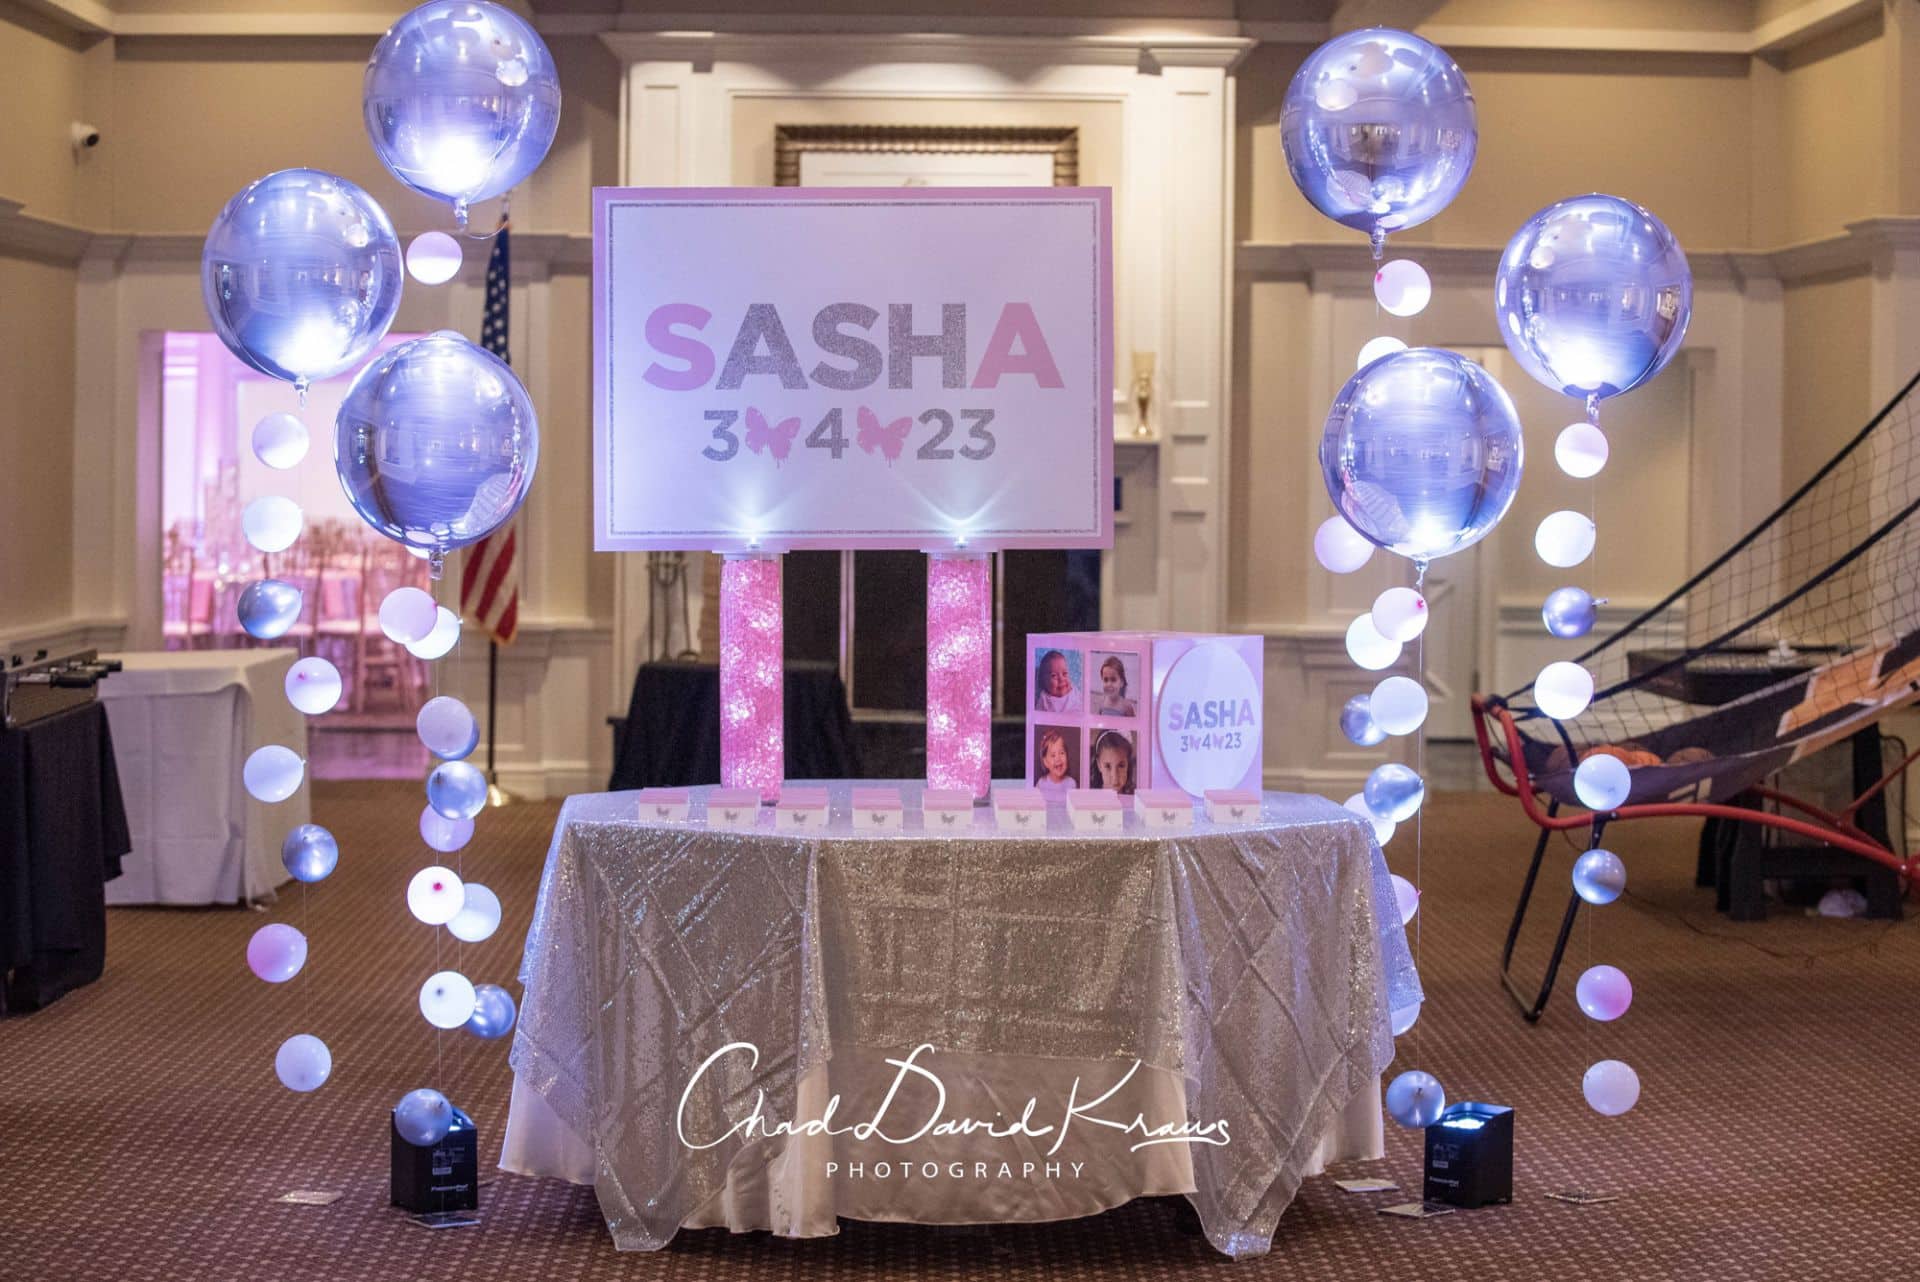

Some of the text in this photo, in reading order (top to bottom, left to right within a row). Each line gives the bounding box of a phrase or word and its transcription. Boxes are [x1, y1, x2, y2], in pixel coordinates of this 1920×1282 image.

[642, 302, 1066, 392] SASHA
[701, 407, 997, 462] 3 4 23
[1168, 699, 1255, 731] SASHA
[1180, 732, 1242, 752] 3 4 23
